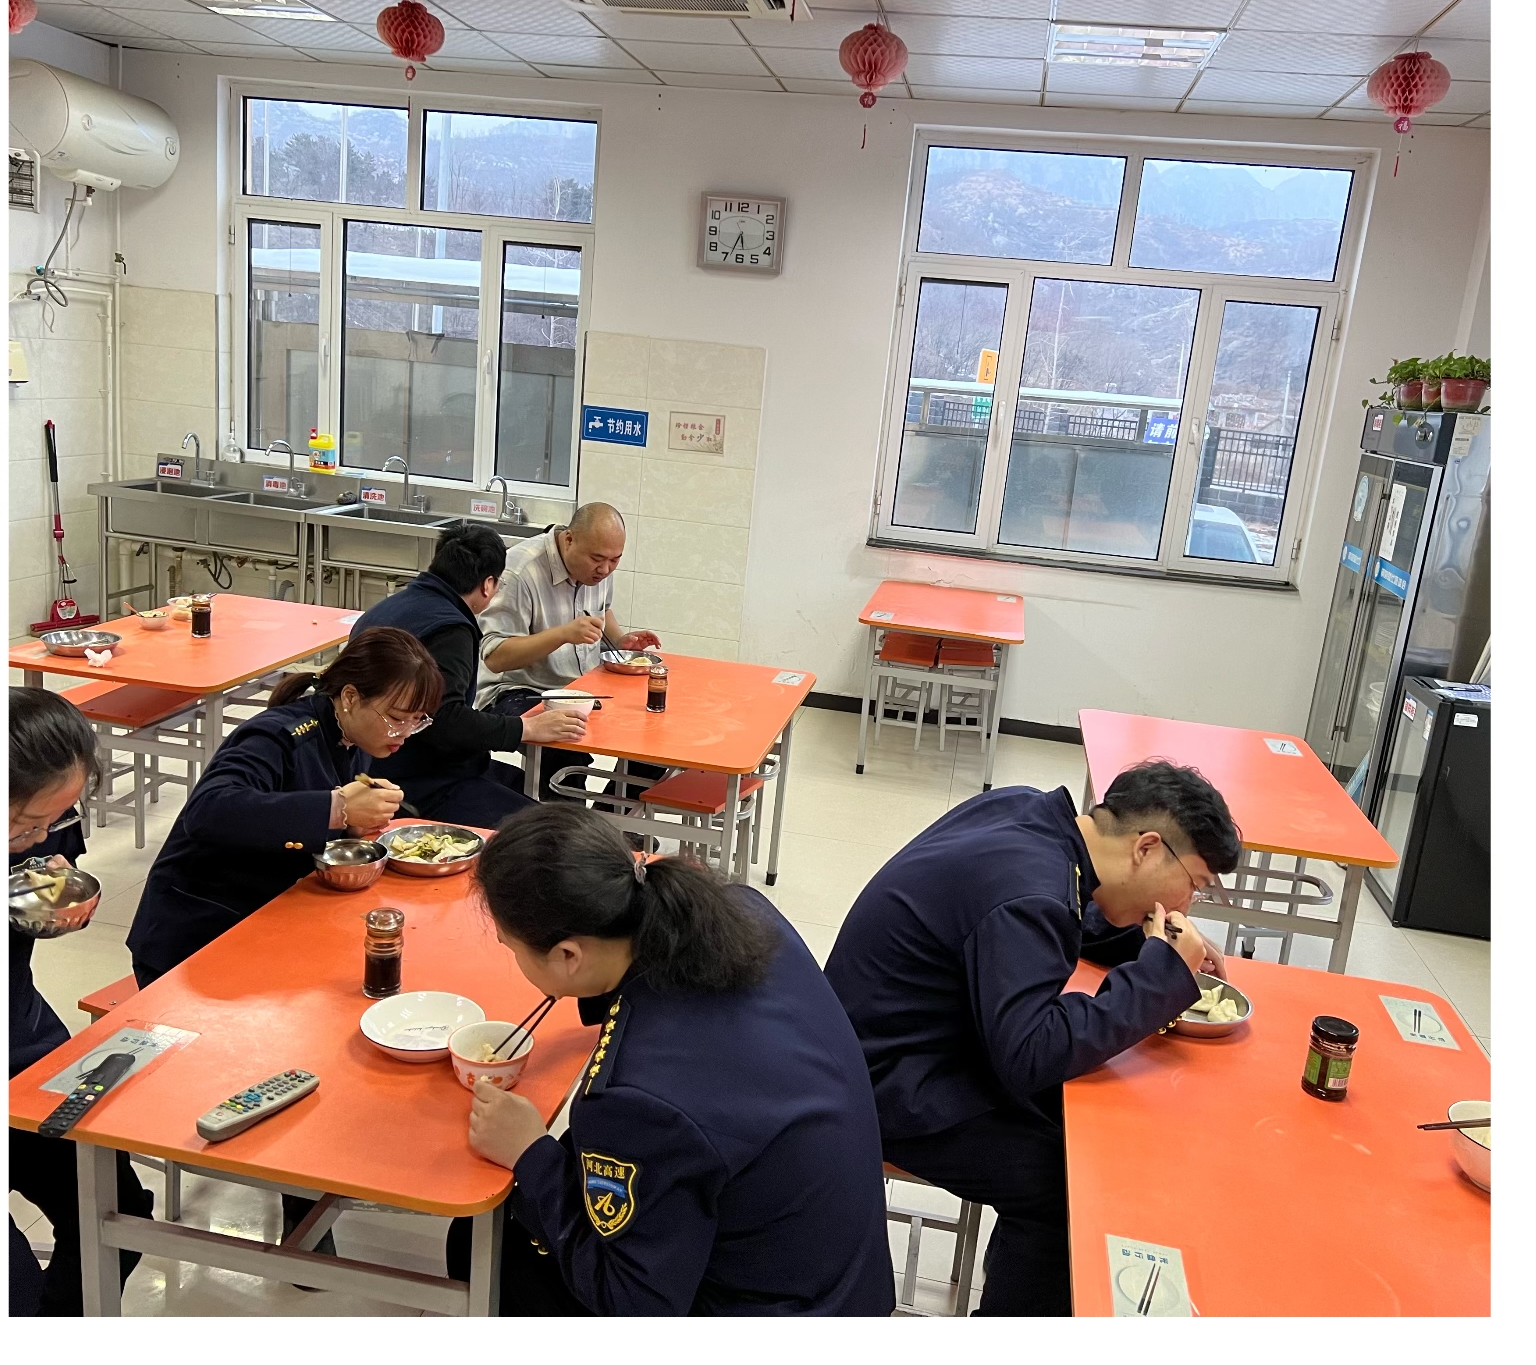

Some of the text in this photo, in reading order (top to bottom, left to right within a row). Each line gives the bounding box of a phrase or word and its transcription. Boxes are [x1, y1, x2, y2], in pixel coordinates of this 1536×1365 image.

[724, 202, 732, 212] 11
[737, 202, 749, 212] 12
[757, 204, 760, 214] 1
[711, 210, 720, 220] 10
[765, 214, 774, 224] 2
[709, 226, 717, 235] 9
[765, 230, 774, 240] 3
[709, 241, 717, 251] 8
[762, 246, 771, 256] 4
[721, 251, 729, 261] 7
[735, 254, 744, 263] 6
[749, 254, 759, 264] 5
[607, 417, 642, 437] 节约用水
[1149, 422, 1178, 439] 请前
[265, 480, 286, 489] 消毒池
[363, 492, 385, 501] 清洗池
[586, 1158, 625, 1179] 河北高速
